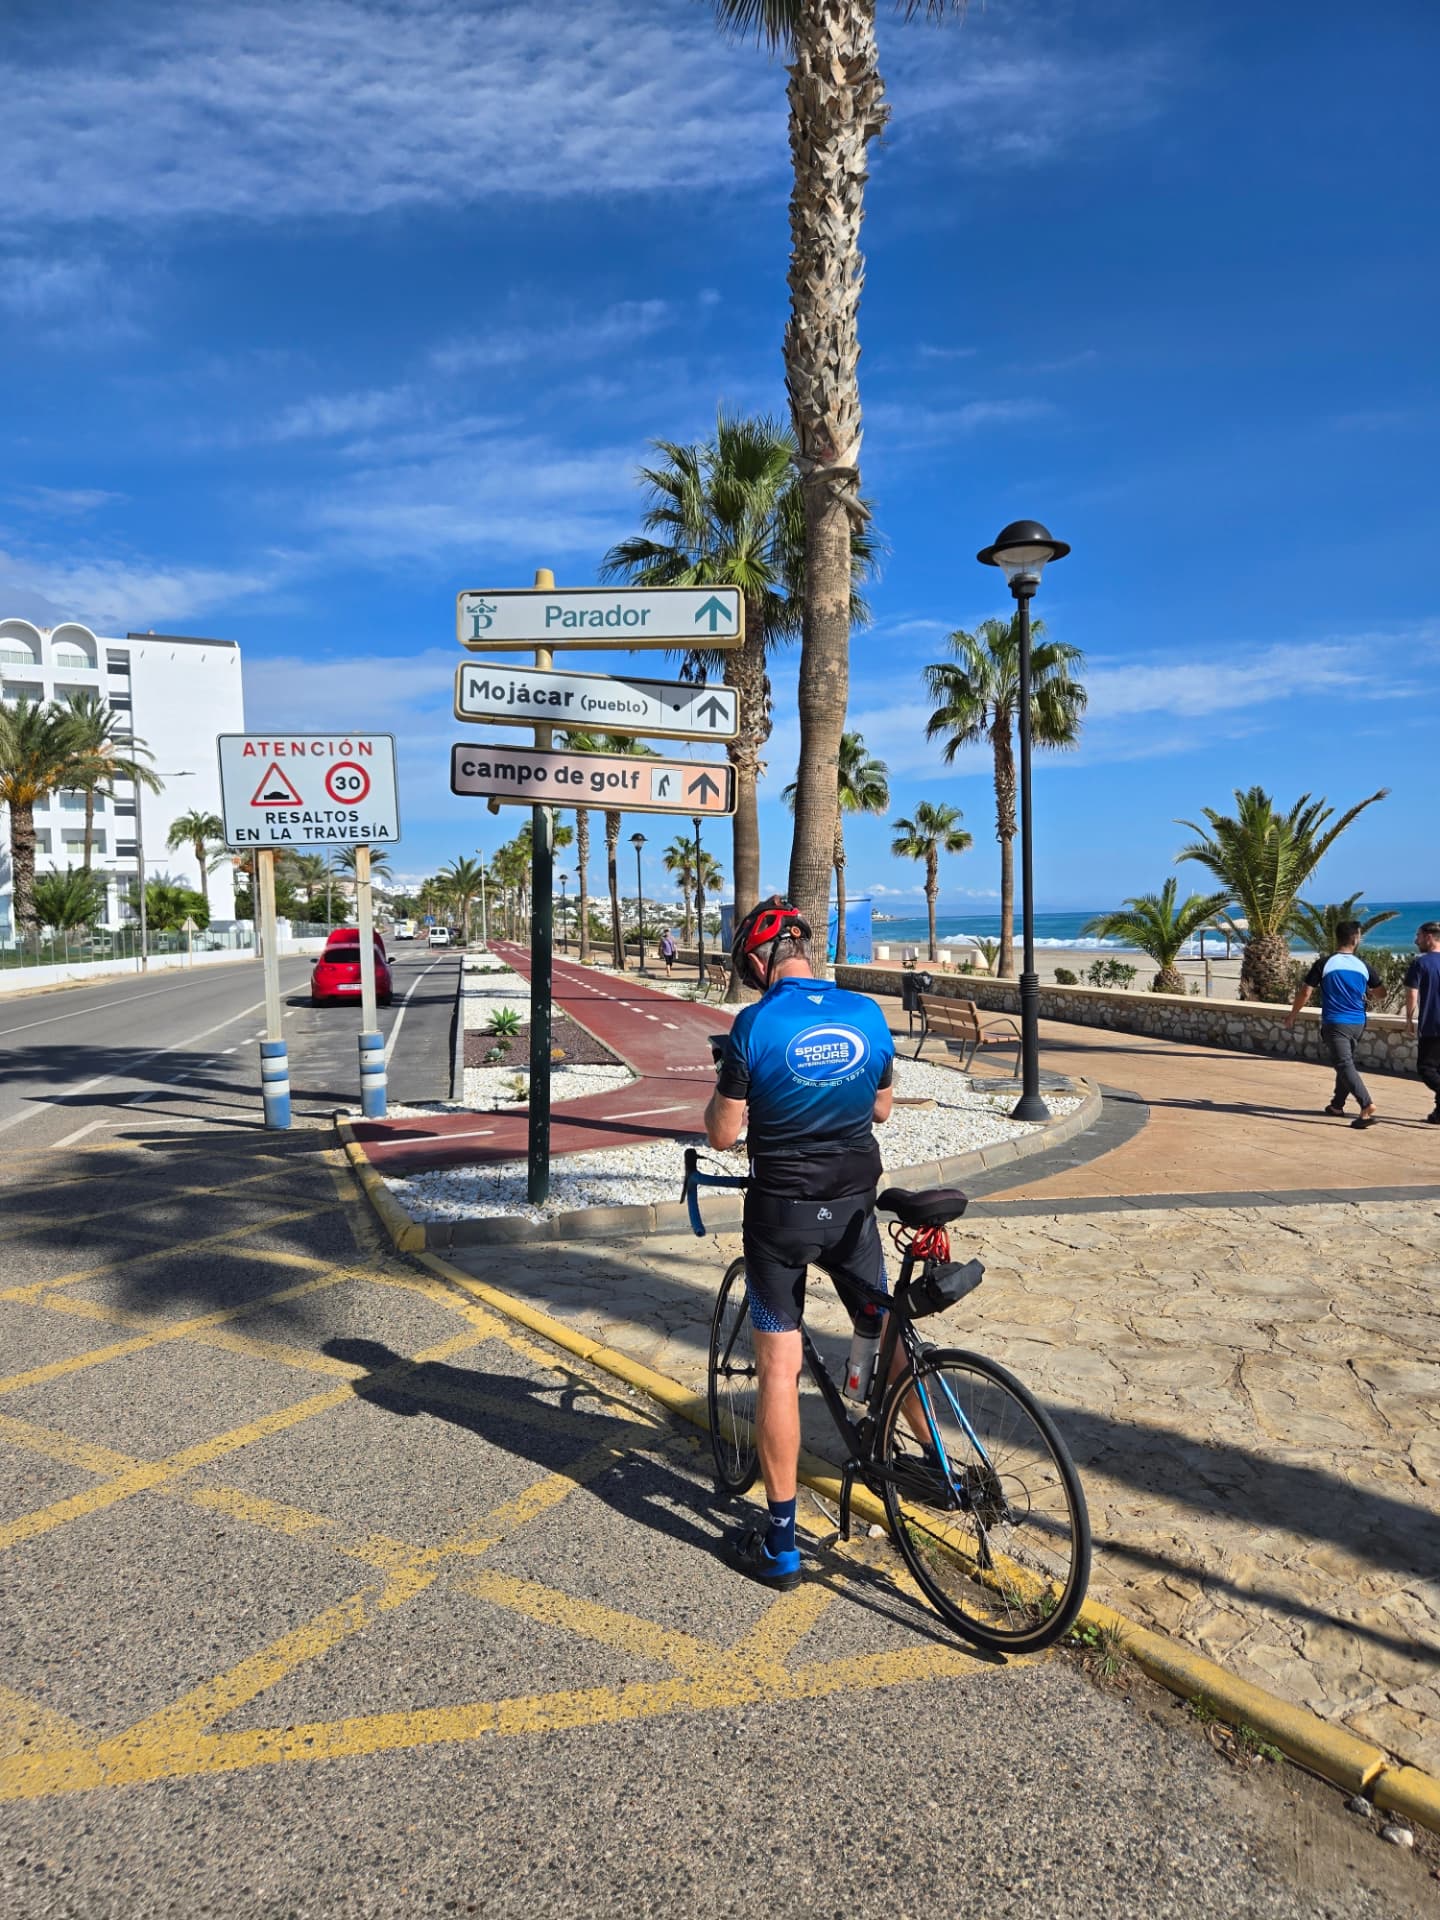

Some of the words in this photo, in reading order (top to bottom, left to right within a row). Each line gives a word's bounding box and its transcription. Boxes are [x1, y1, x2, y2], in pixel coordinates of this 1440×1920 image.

[545, 604, 651, 628] Parador
[469, 679, 574, 707] Mojácar
[580, 694, 648, 715] (pueblo)
[242, 738, 373, 757] ATENCIÓN
[335, 776, 360, 790] 30
[461, 761, 548, 785] campo
[554, 766, 585, 785] de
[590, 770, 640, 792] golf
[265, 810, 359, 824] RESALTOS
[236, 828, 260, 841] EN
[271, 828, 292, 840] LA
[303, 822, 389, 839] TRAVESÍA
[795, 1042, 849, 1056] SPORTS
[803, 1049, 849, 1062] TOURS
[798, 1058, 848, 1068] INTERNATIONAL
